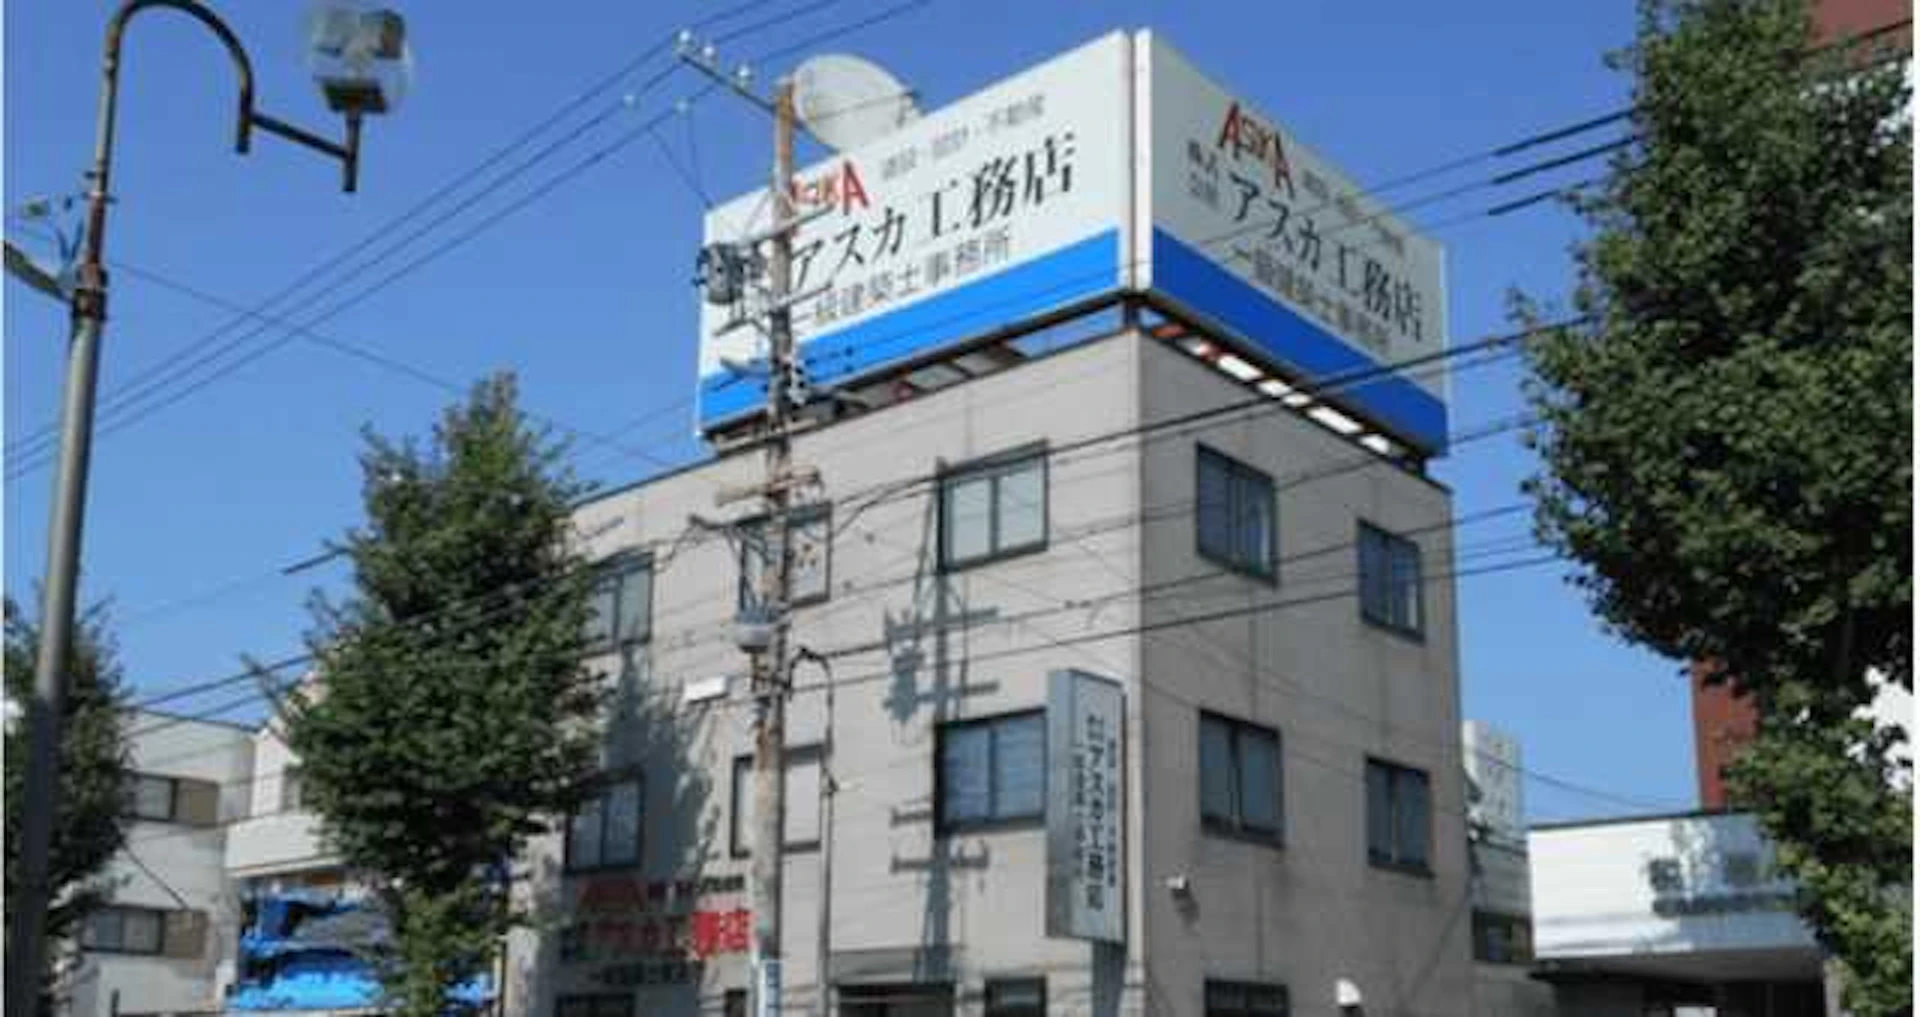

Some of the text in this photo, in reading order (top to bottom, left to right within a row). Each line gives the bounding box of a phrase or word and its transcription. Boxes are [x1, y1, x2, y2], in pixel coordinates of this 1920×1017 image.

[791, 131, 1075, 288] アスカ工務店
[1229, 171, 1422, 342] アスカ工務店
